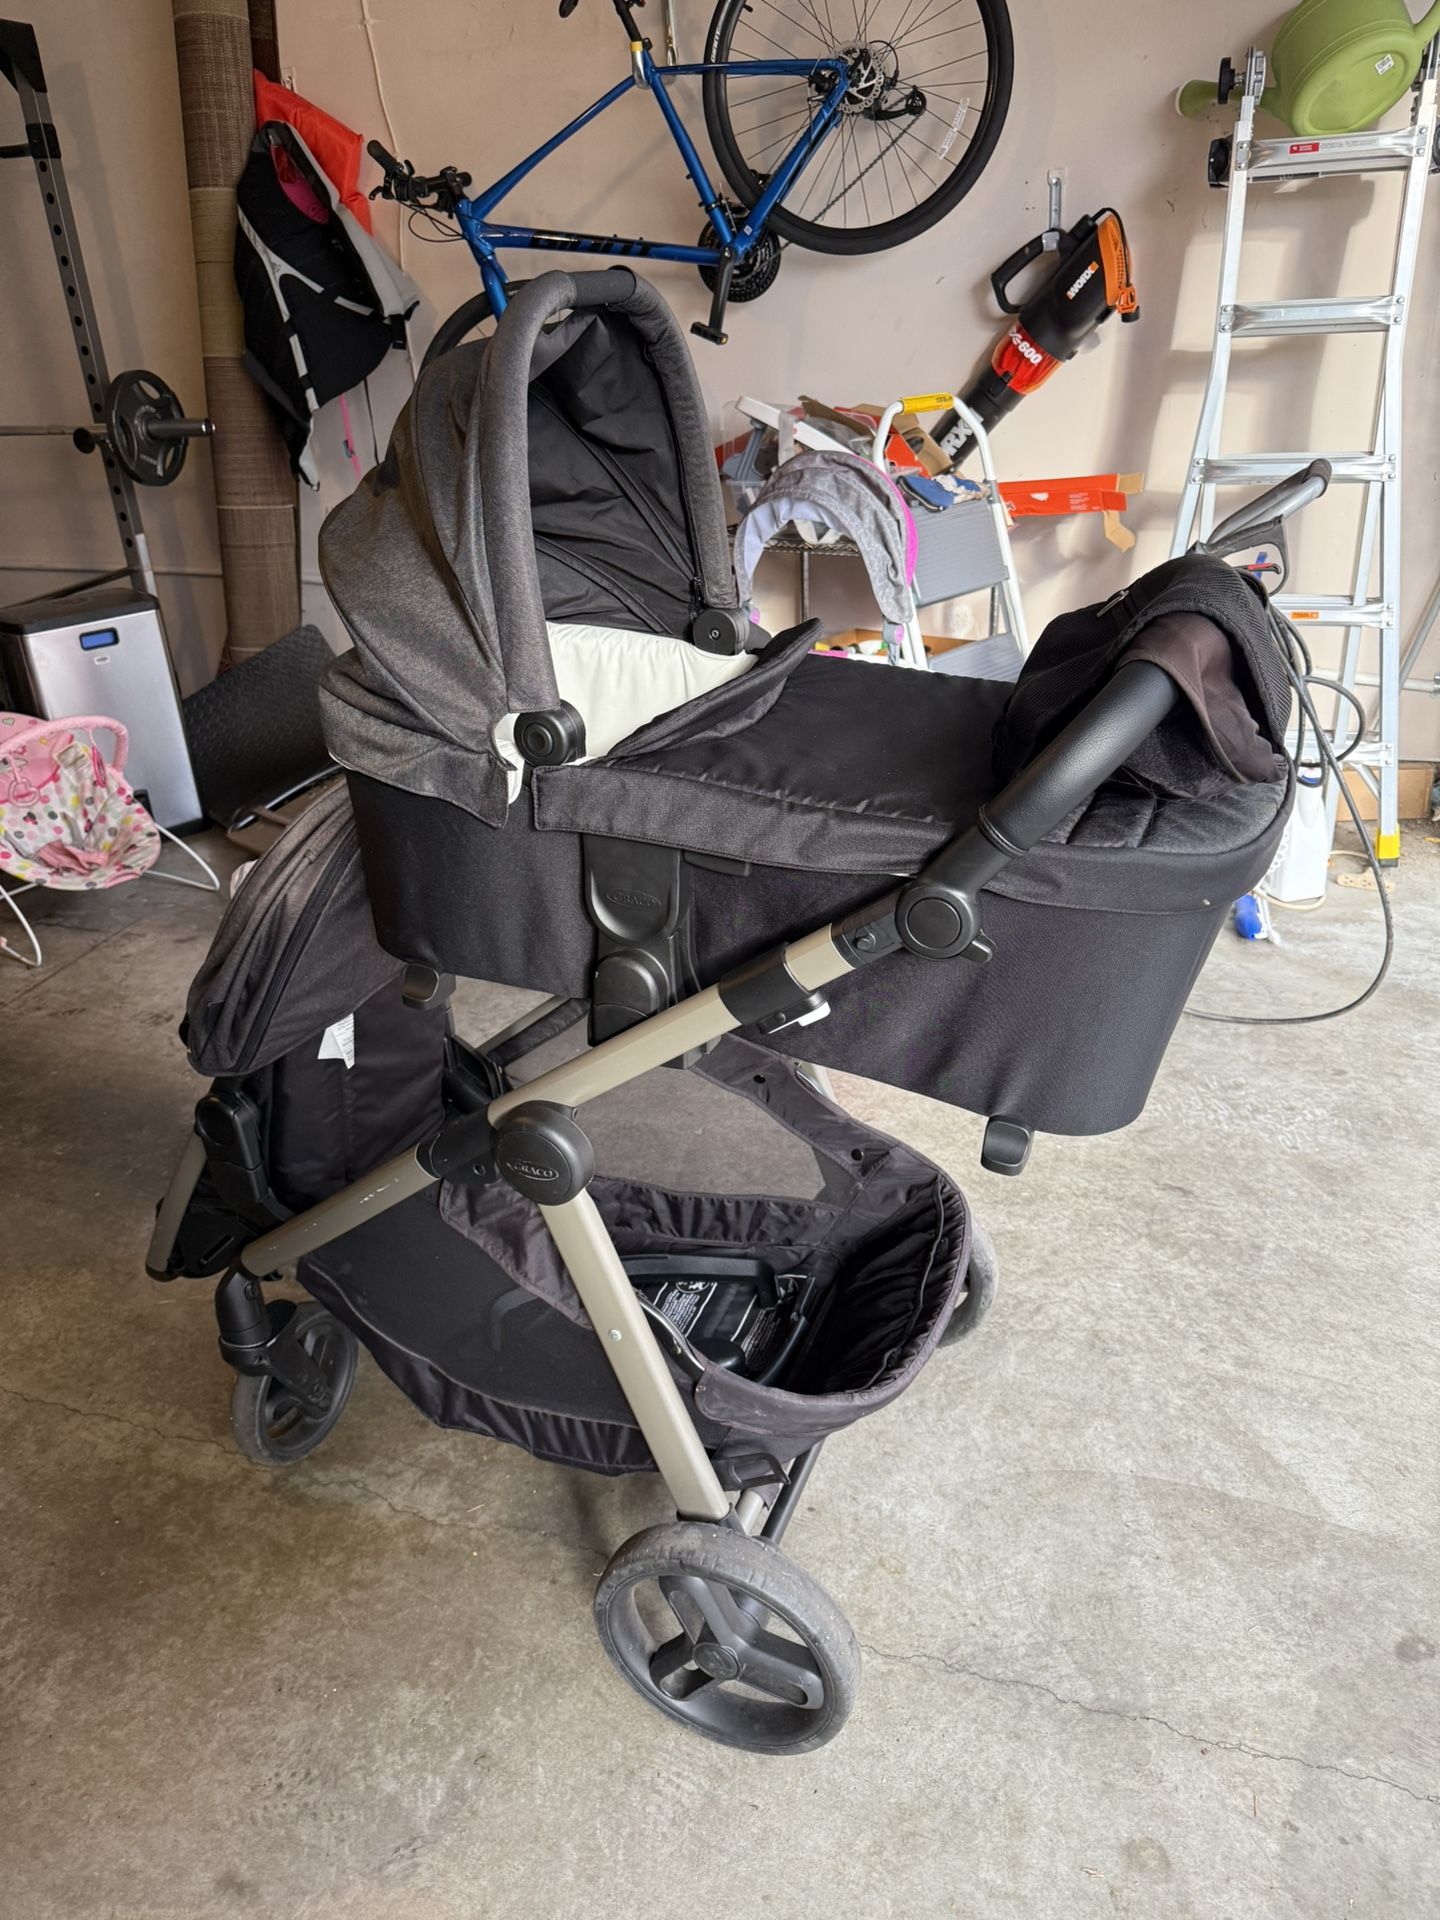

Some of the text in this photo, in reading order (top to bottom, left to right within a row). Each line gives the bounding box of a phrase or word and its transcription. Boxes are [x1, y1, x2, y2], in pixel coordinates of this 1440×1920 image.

[1066, 263, 1095, 300] WORX
[940, 419, 973, 456] RX
[511, 1161, 553, 1178] GRACO
